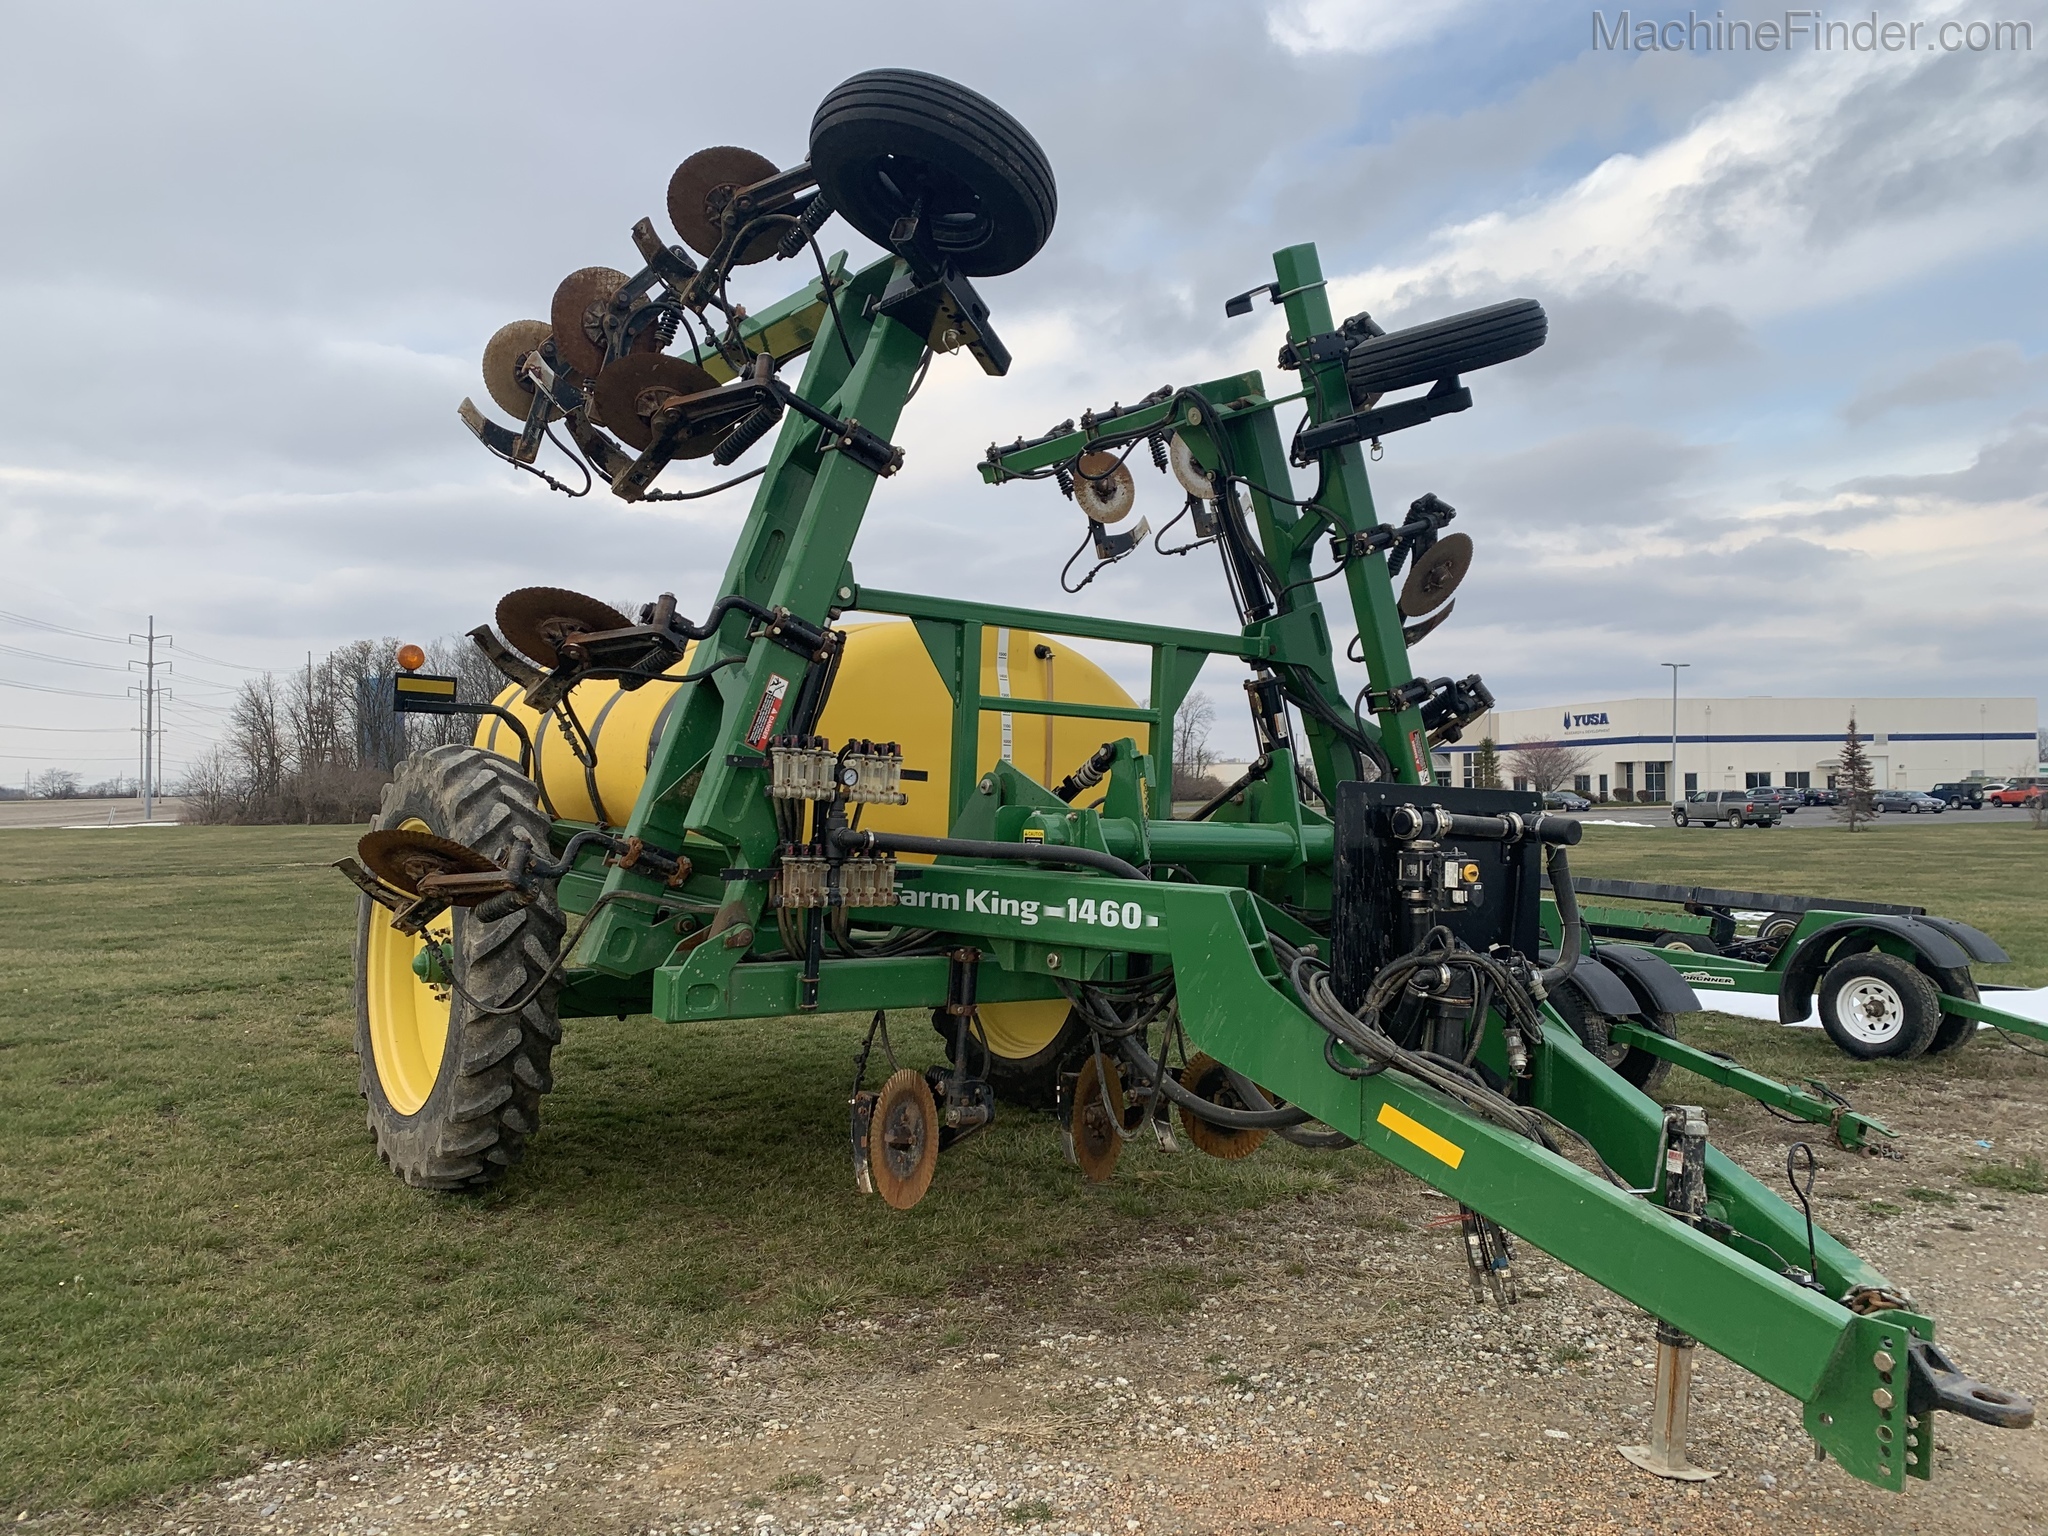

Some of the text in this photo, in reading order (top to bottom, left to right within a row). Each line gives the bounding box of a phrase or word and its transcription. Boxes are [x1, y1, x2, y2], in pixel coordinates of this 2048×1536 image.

[761, 716, 775, 740] DANGER
[1573, 713, 1609, 727] YUSA
[966, 888, 1040, 925] King
[1067, 897, 1142, 930] 1460
[1683, 975, 1732, 983] DRUNNER
